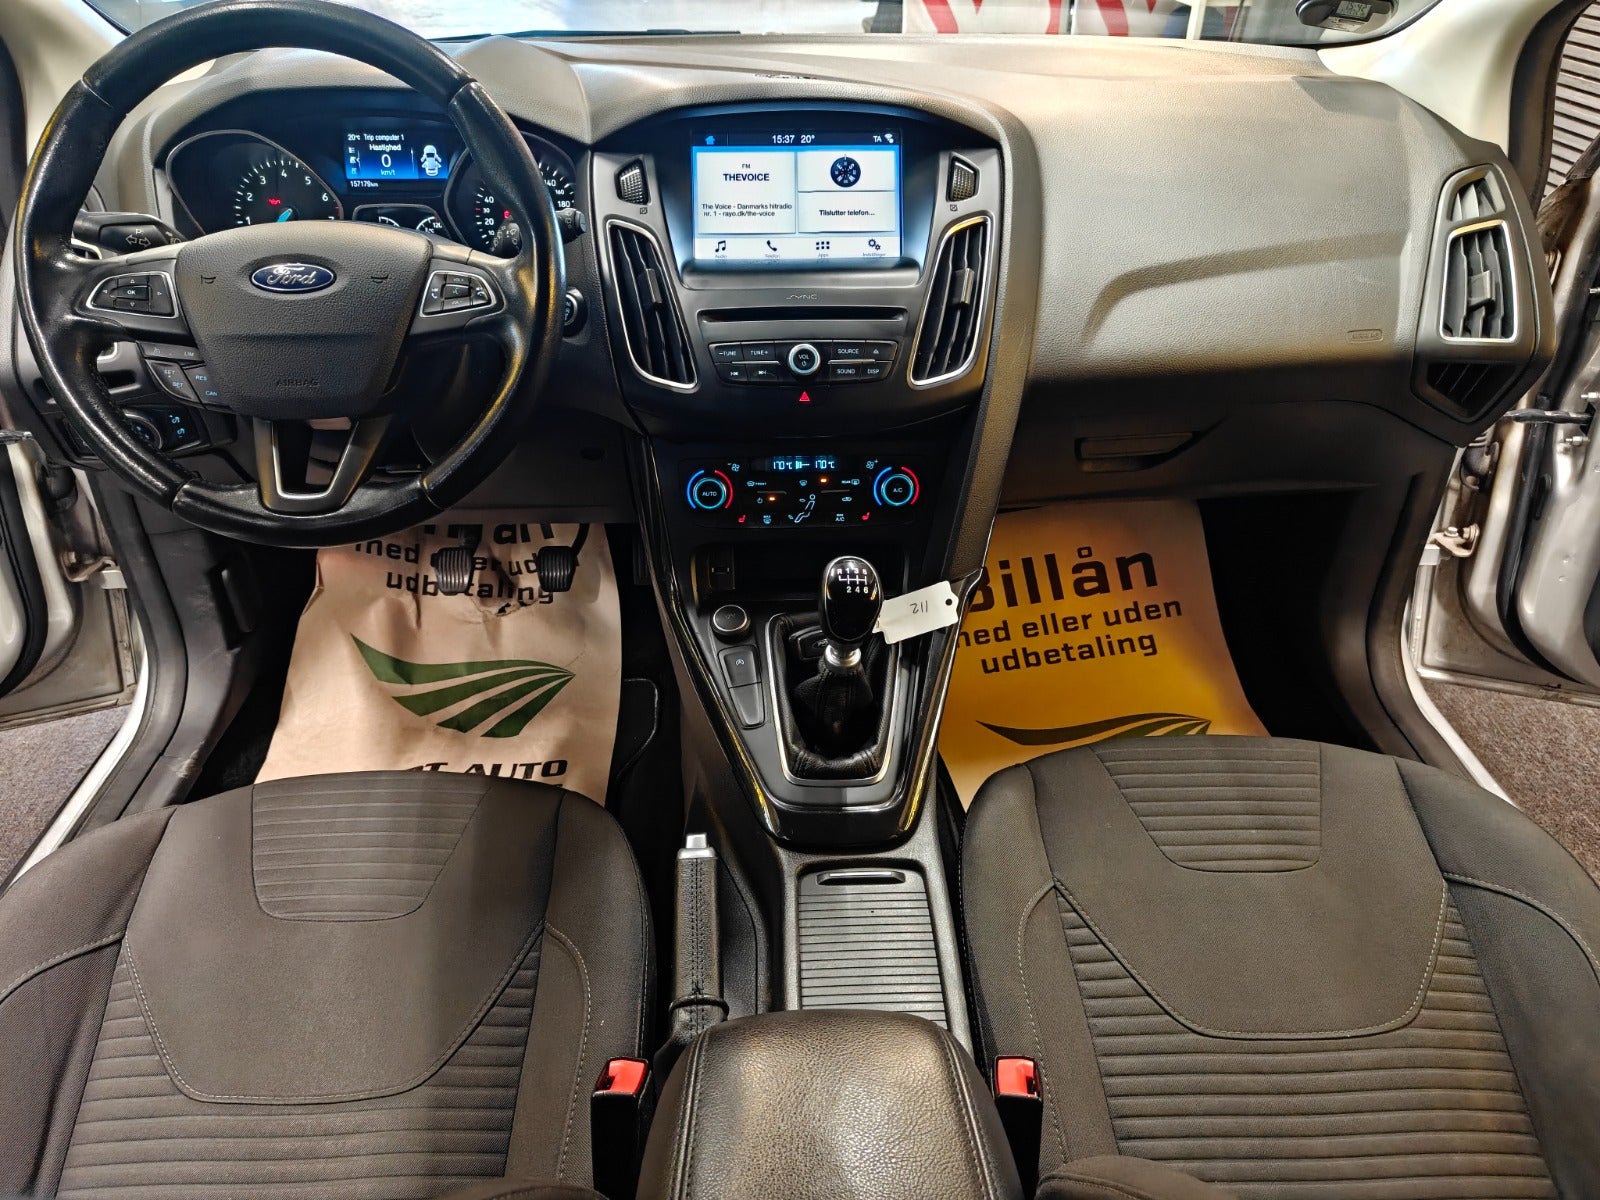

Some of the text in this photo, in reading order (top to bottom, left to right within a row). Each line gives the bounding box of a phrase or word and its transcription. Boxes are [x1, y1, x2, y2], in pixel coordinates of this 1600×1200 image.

[772, 134, 795, 144] 15:37
[873, 135, 882, 143] TA
[369, 144, 402, 152] Hastighed
[381, 153, 392, 168] 0
[281, 169, 288, 178] 4
[722, 173, 770, 182] THEVOICE
[259, 175, 267, 185] 3
[304, 176, 312, 185] 5
[246, 192, 254, 202] 2
[321, 192, 329, 202] 6
[484, 196, 495, 204] 40
[557, 200, 571, 208] 180
[245, 216, 251, 225] 1
[484, 217, 495, 226] 20
[266, 264, 317, 285] Ford
[386, 571, 554, 604] udbtaling
[863, 586, 869, 594] 6
[1022, 613, 1092, 638] eller
[1103, 601, 1182, 626] uden
[981, 634, 1158, 674] udbetaling
[464, 760, 568, 780] AUTO
